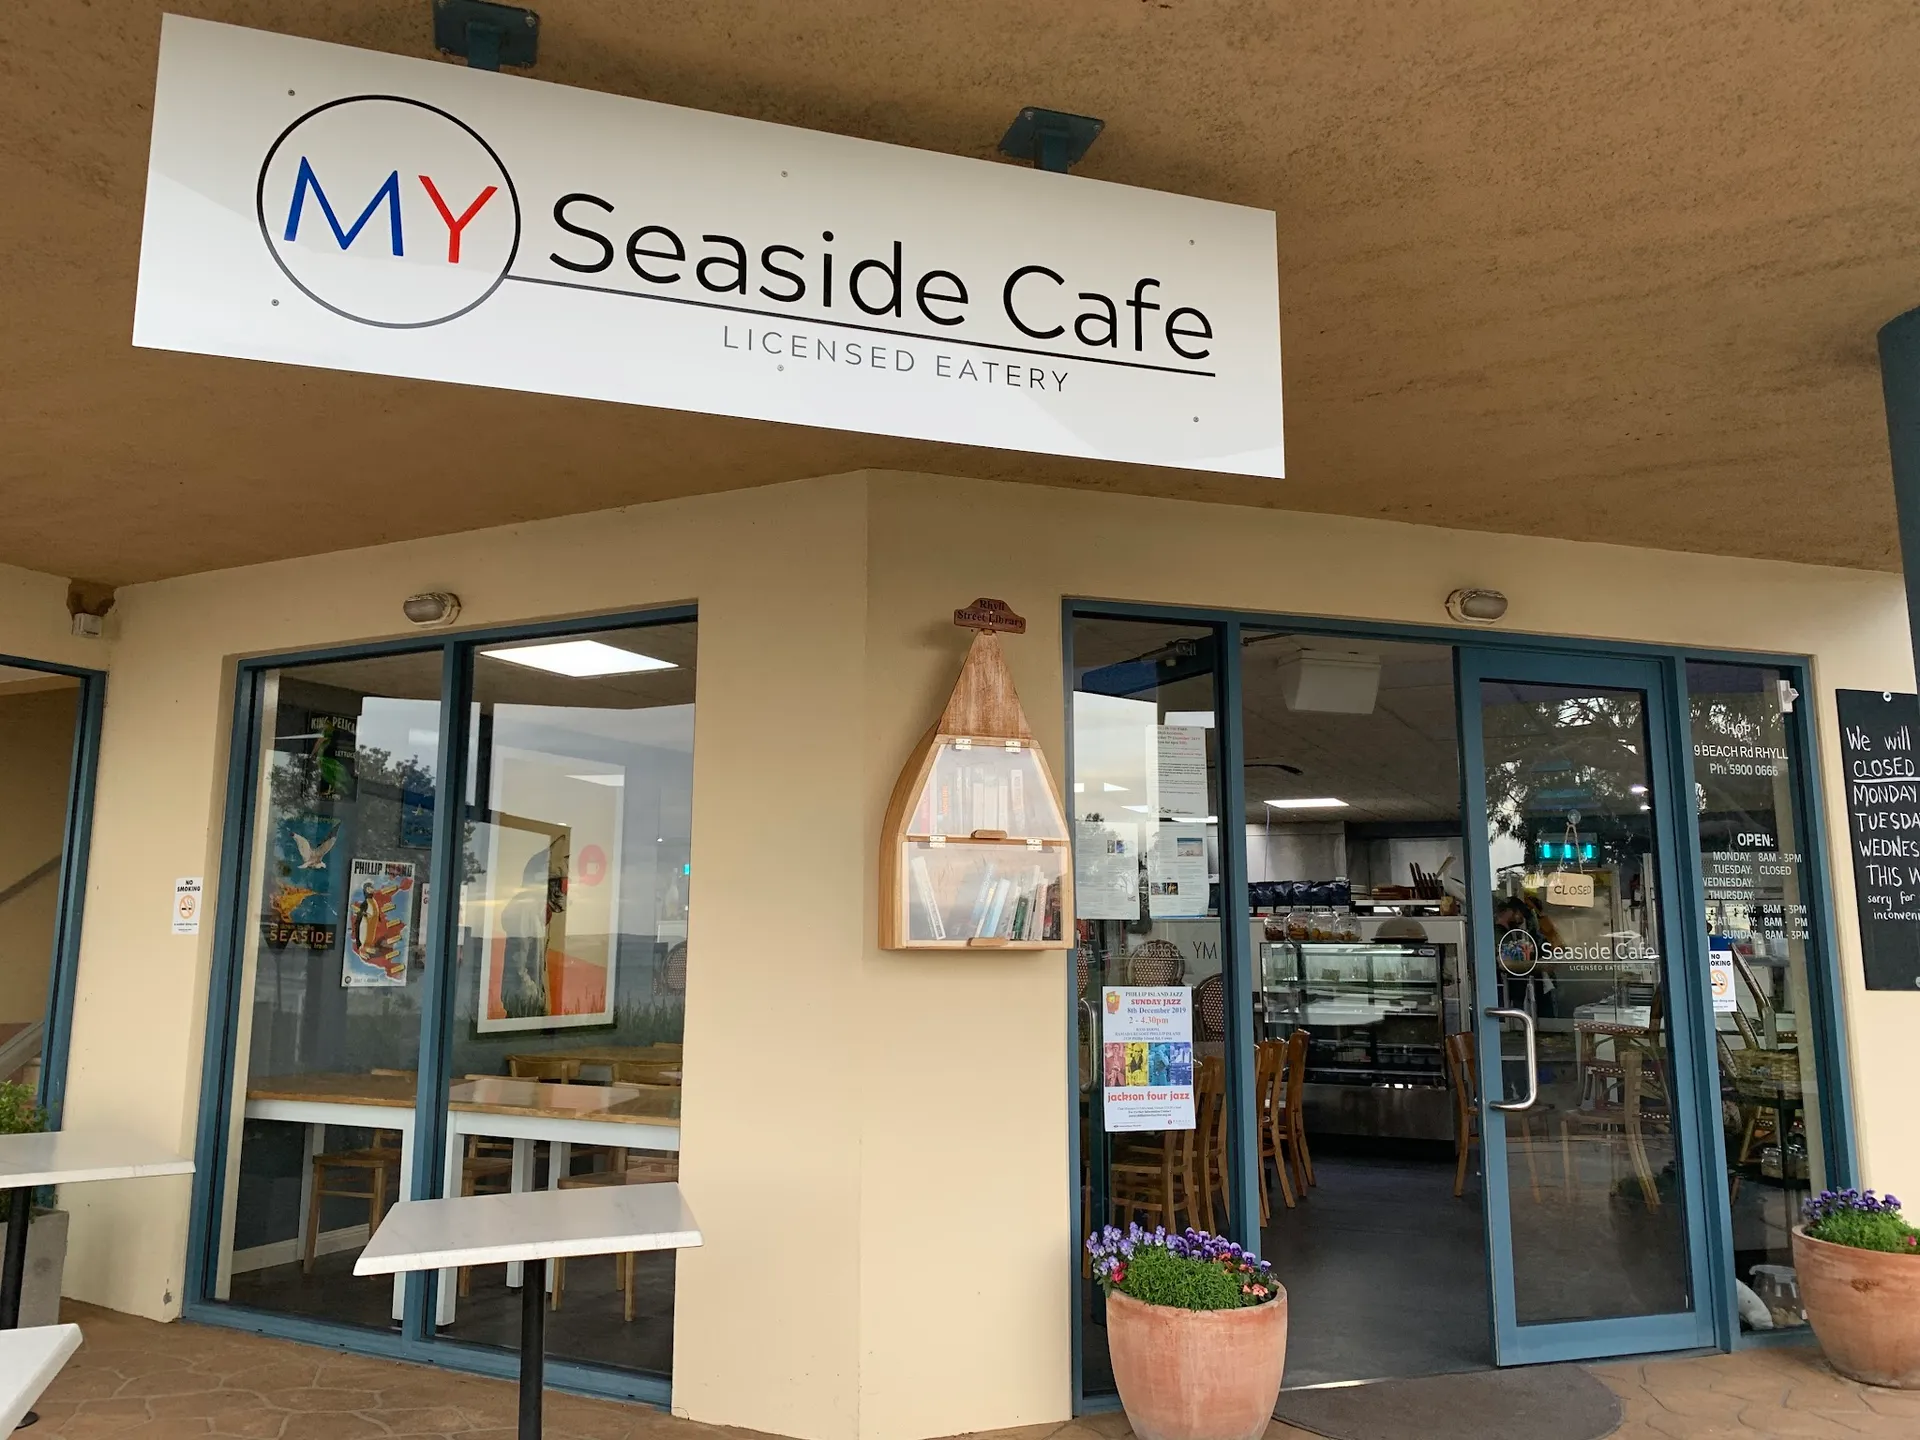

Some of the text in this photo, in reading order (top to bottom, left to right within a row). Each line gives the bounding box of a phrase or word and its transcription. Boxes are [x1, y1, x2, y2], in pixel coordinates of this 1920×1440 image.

[284, 156, 1213, 360] MY Seaside Cafe
[723, 325, 1070, 392] LICENSED EATERY
[957, 609, 1024, 628] Street Library
[332, 716, 357, 735] PELICA
[1719, 722, 1761, 737] SHOP 1
[1846, 725, 1911, 751] We will
[1693, 744, 1789, 760] 9 BEACH Rd RHYLL
[1709, 763, 1727, 775] Ph:
[1729, 763, 1753, 776] 5900
[1853, 756, 1915, 778] CLOSED
[1853, 784, 1917, 807] MONDAY
[1854, 811, 1920, 832] TUESDA
[1737, 833, 1775, 847] OPEN:
[1859, 836, 1920, 857] WEDNES
[1713, 851, 1752, 862] MONDAY:
[1758, 853, 1777, 862] 8AM
[1784, 853, 1802, 863] 3PM
[354, 861, 413, 877] PHILLIP ISND
[1713, 864, 1792, 876] TUESDAY: CLOSED
[1865, 864, 1903, 887] THIS
[1553, 884, 1592, 896] CLOSED
[1709, 890, 1756, 900] THURSDAY:
[1867, 890, 1916, 911] sorry for
[1763, 904, 1782, 914] 8AM
[1788, 904, 1807, 914] 3PM
[1711, 916, 1758, 927] SATUAY:
[1764, 917, 1783, 927] 8AM
[269, 929, 334, 944] SEASIDE
[1765, 930, 1784, 940] 8AM
[1791, 930, 1809, 940] 3PM
[1541, 942, 1611, 960] Seaside
[1615, 942, 1656, 960] Cafe
[1163, 998, 1182, 1006] JAZZ
[1140, 1016, 1169, 1026] 4.30pm
[1107, 1090, 1190, 1103] jackson four jazz
